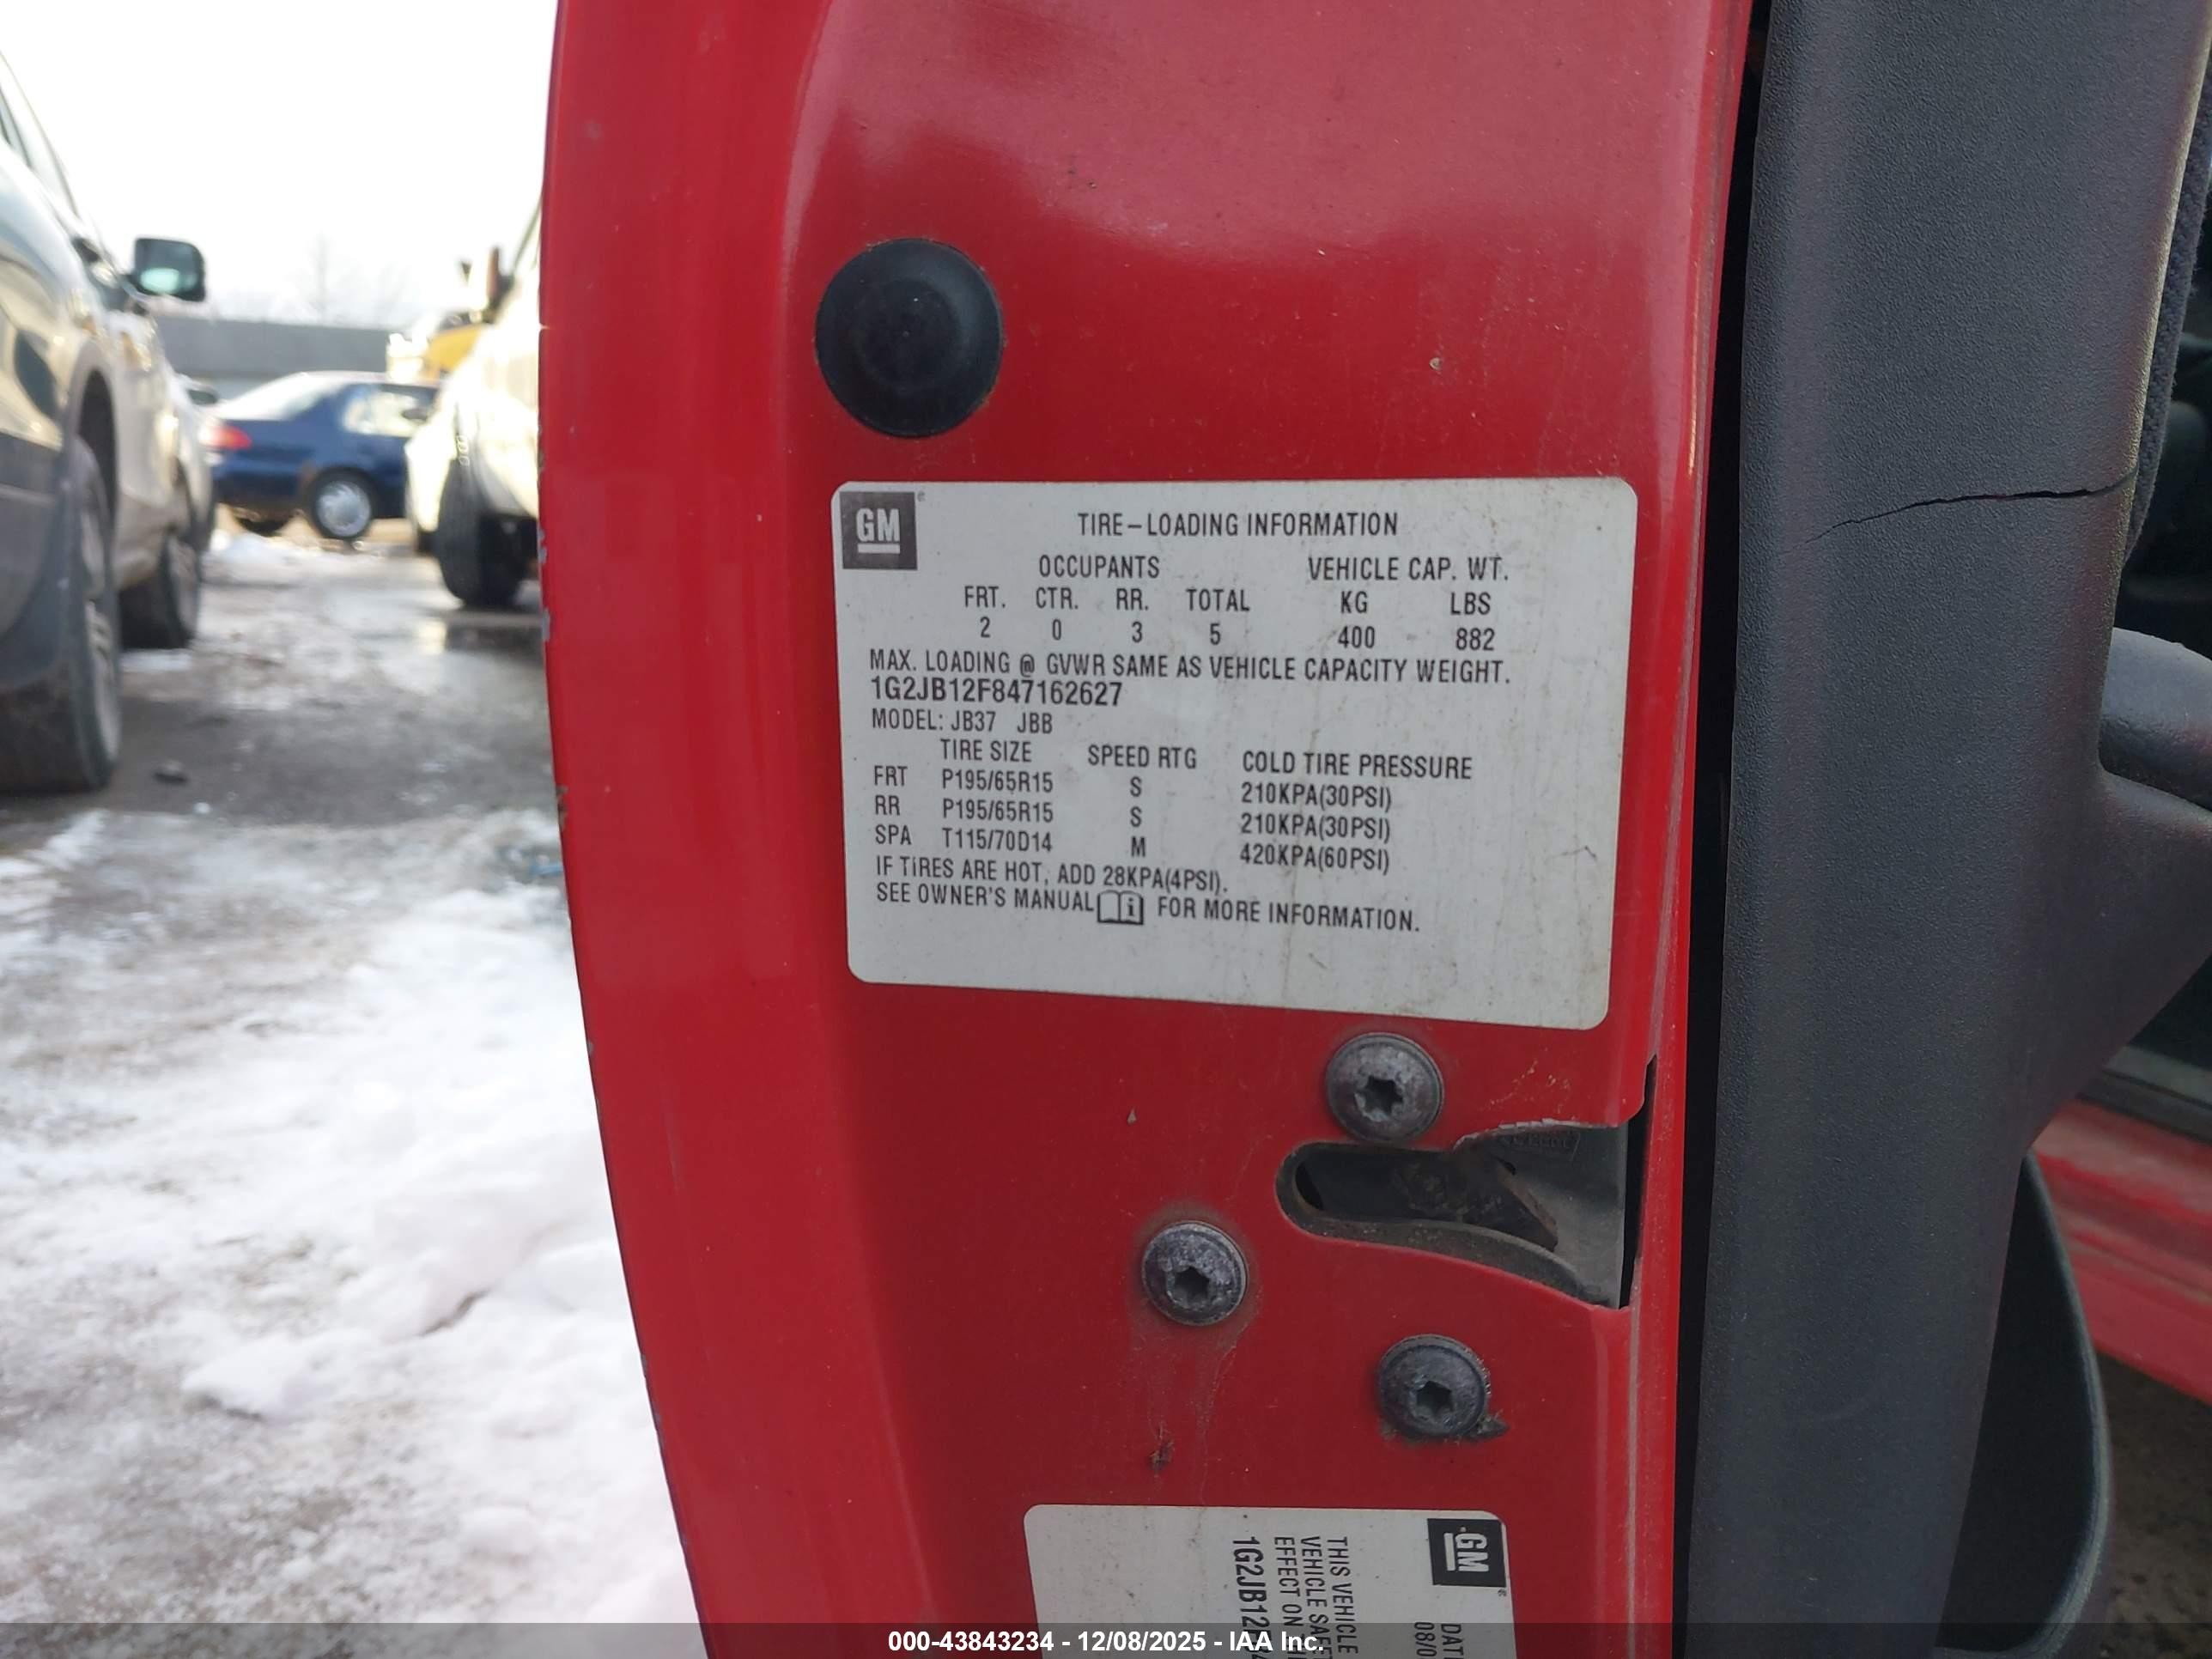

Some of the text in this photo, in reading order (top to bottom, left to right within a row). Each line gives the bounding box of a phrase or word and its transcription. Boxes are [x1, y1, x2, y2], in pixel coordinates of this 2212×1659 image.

[856, 508, 900, 542] GM
[1247, 512, 1398, 536] INFORMATION
[1038, 555, 1160, 579] OCCUPANTS
[1307, 556, 1509, 580] VEHICLE CAP. WT.
[963, 585, 1251, 612] FRT. CTR. RR. TOTAL
[1340, 591, 1492, 616] KG LBS
[979, 616, 1222, 646] 2 0 3 5
[1335, 625, 1496, 651] 400 882
[869, 648, 1510, 684] MAX. LOADING @ GVWR SAME AS VEHICLE CAPACITY WEIGHT.
[870, 675, 1123, 707] 1G2JB12F847162627
[872, 708, 1054, 734] MODEL: JB37 JBB
[939, 738, 1032, 763] TIRE SIZE
[1087, 744, 1197, 769] SPEED RTG
[1242, 750, 1473, 780] COLD TIRE PRESSURE
[873, 765, 1393, 814] FRT P195/65R15 S 210KPA(30PSI)
[874, 794, 1391, 845] RR P195/65R15 S 210KPA(30PSI)
[874, 823, 1390, 876] SPA T115/70D14 M 420KPA(60PSI)
[876, 855, 894, 876] IF
[899, 856, 954, 878] TIRES
[962, 859, 998, 880] ARE
[1057, 863, 1096, 884] ADD
[876, 882, 911, 902] SEE
[917, 884, 1006, 907] OWNER'S
[1013, 888, 1097, 913] MANUAL
[1158, 896, 1197, 919] FOR
[1203, 899, 1261, 922] MORE
[1268, 902, 1420, 932] INFORMATION.
[1274, 1537, 1300, 1597] EFFECT
[1455, 1533, 1489, 1571] GM
[1301, 1536, 1328, 1607] VEHICLE
[1327, 1536, 1358, 1654] THIS VEHICLE
[1282, 1604, 1304, 1626] ON
[1414, 1622, 1437, 1659] 08/0
[1441, 1623, 1464, 1659] DAT
